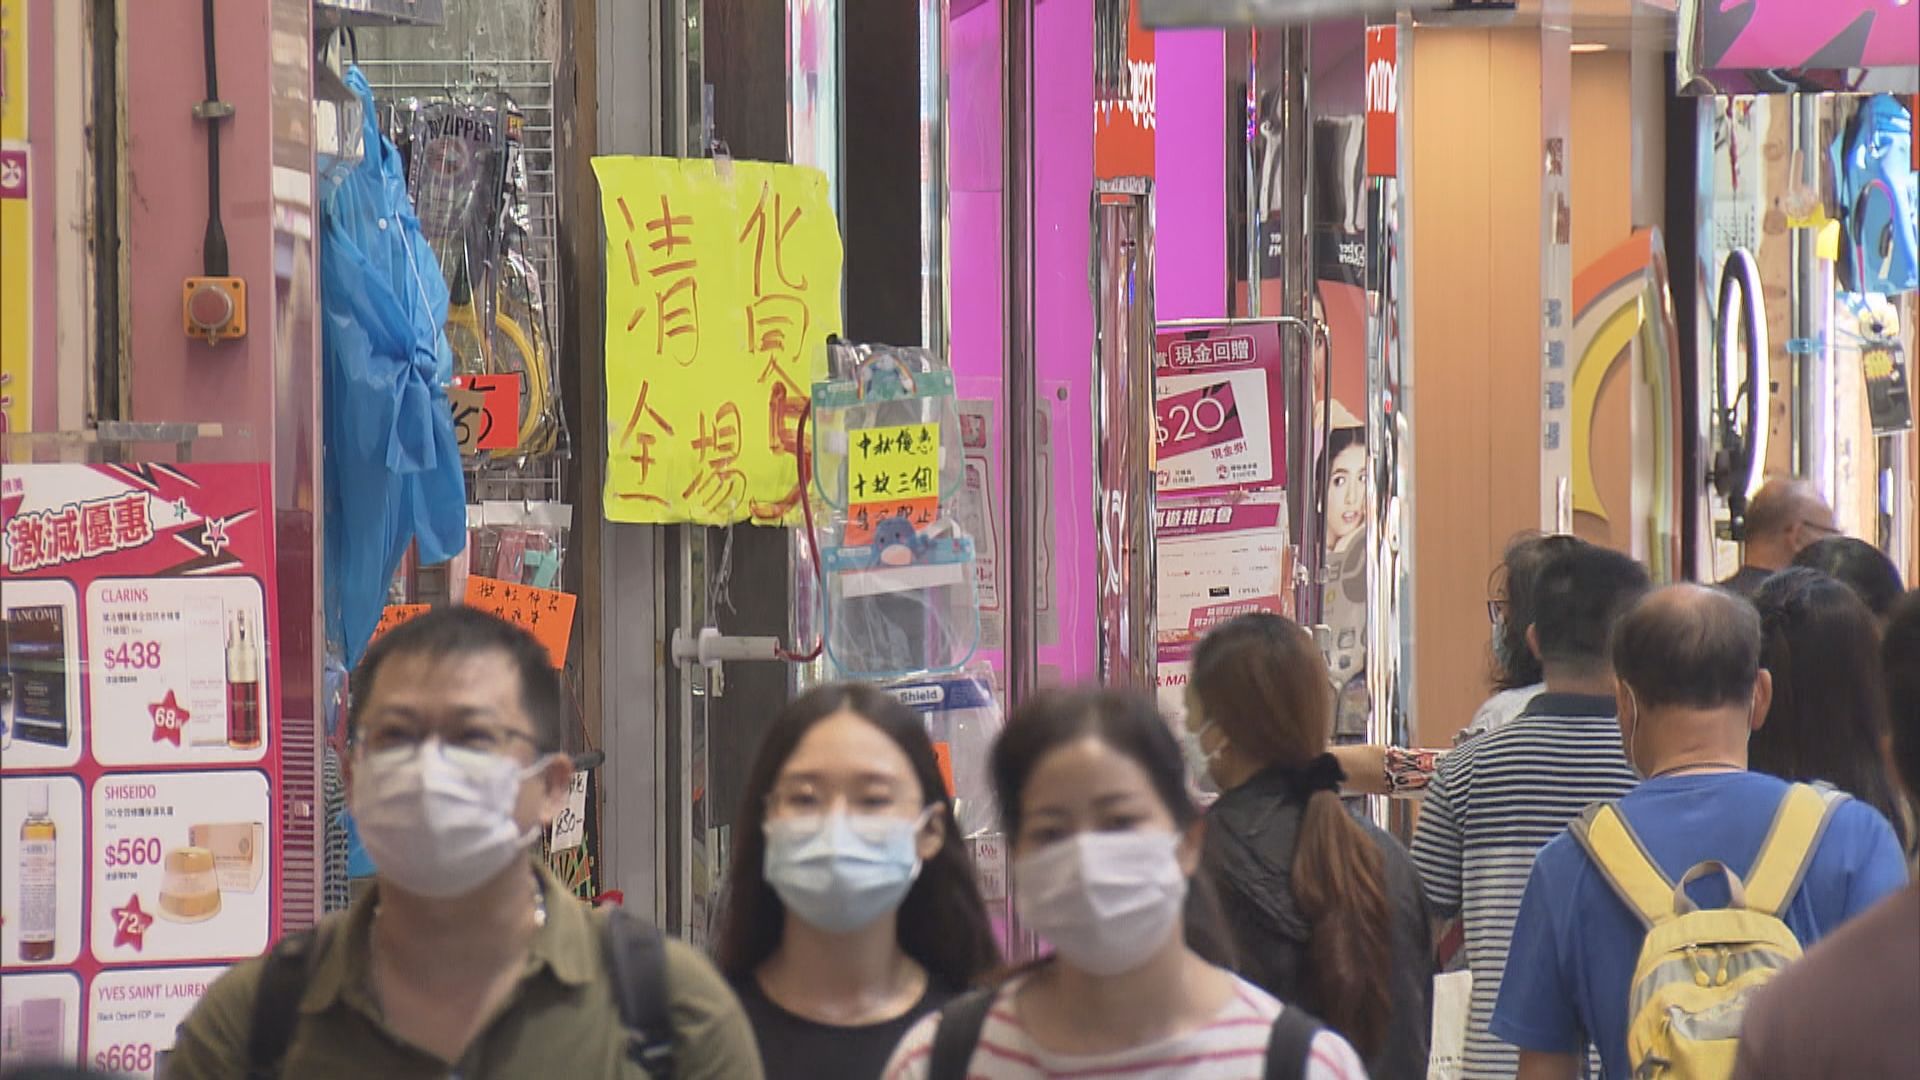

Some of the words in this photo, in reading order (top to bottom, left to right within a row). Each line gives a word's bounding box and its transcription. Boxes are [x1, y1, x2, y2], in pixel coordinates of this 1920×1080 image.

[1175, 338, 1249, 364] 現金回贈
[1155, 397, 1225, 447] $20
[856, 426, 934, 460] 中秋優惠
[9, 493, 151, 570] 激減優惠
[101, 588, 149, 603] CLARINS
[104, 641, 162, 670] $438
[900, 690, 938, 702] Shield
[104, 784, 157, 800] SHISEIDO
[104, 837, 161, 868] $560
[98, 984, 126, 1001] YVES
[128, 984, 163, 1000] SAINT
[95, 1042, 153, 1075] $668
